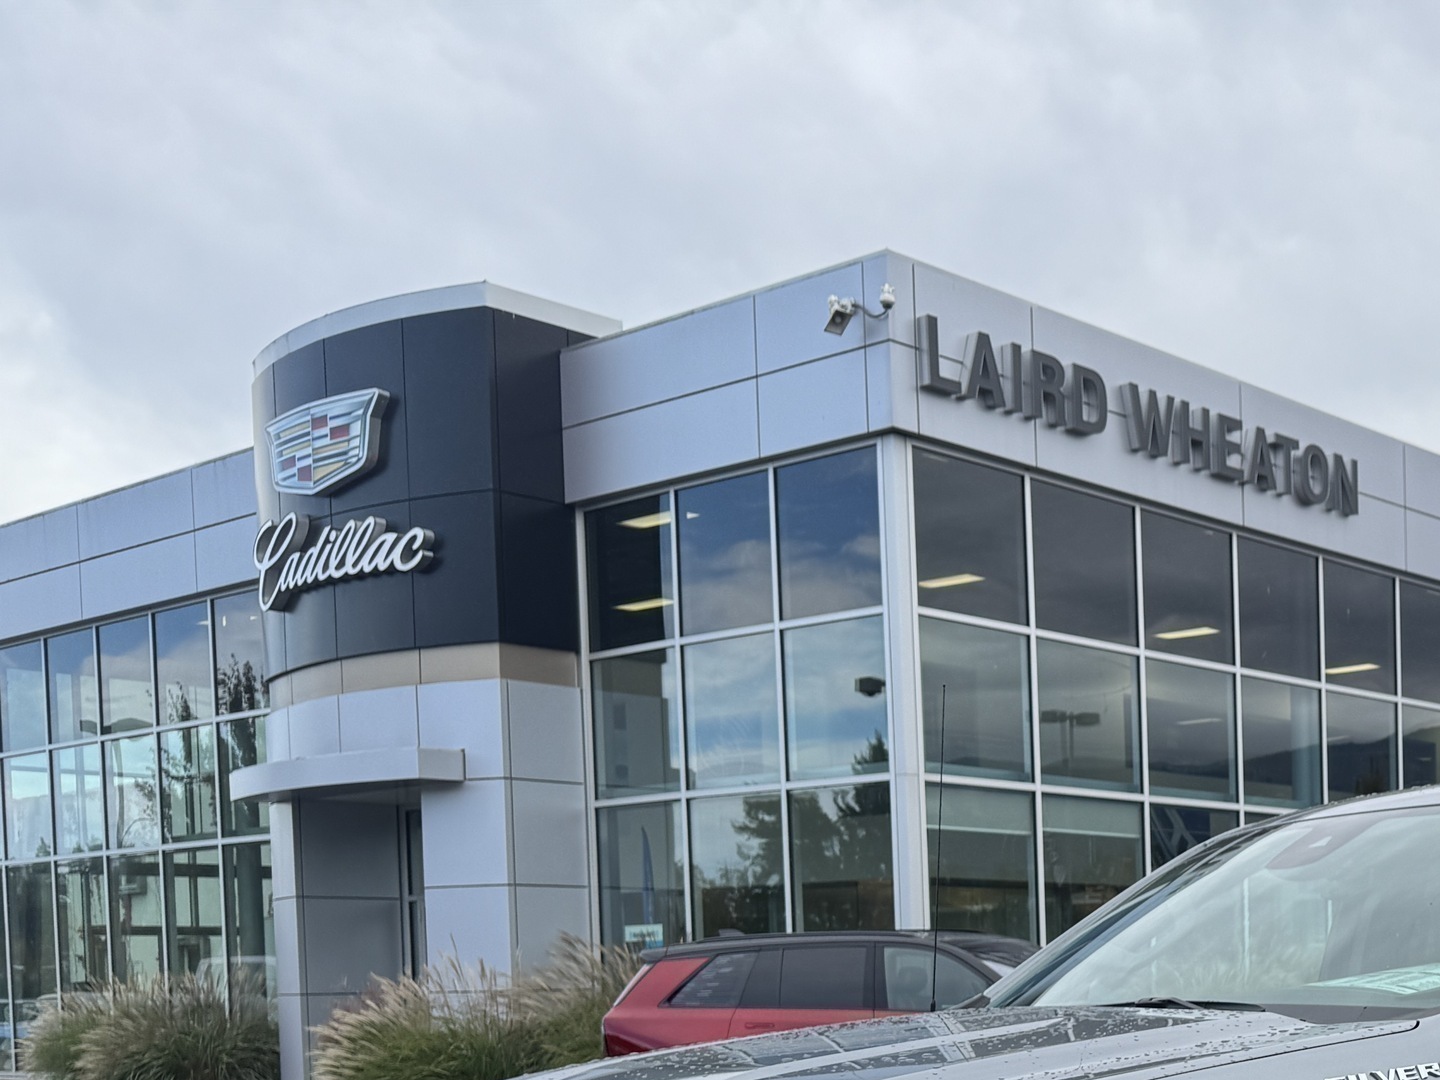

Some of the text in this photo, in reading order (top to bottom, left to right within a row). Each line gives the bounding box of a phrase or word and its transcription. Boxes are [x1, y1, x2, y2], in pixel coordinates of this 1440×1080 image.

[916, 313, 1359, 517] LAIRD WHEATON
[253, 511, 434, 612] Cadillac
